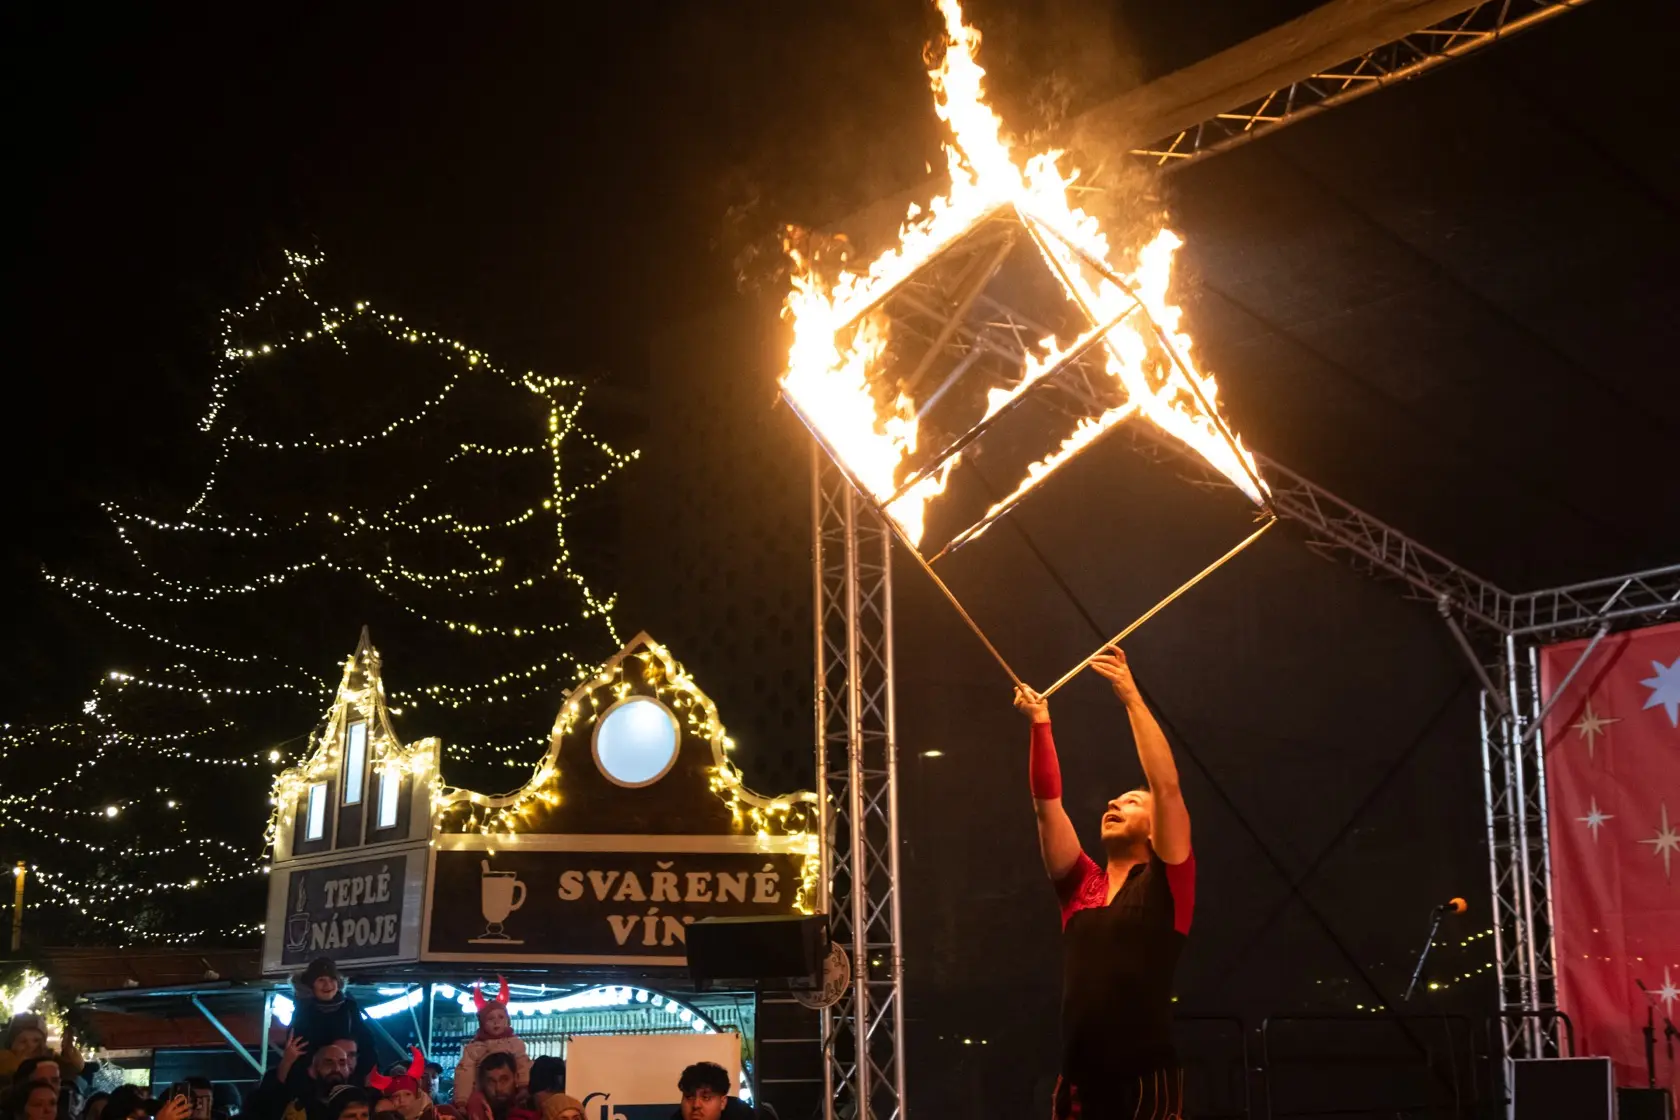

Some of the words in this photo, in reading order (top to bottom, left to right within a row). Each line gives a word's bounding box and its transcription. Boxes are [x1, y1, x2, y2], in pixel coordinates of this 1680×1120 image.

[324, 865, 391, 909] TEPLÉ
[558, 861, 781, 903] SVAŘENÉ
[309, 913, 398, 951] NÁPOJE
[606, 907, 696, 946] VÍN
